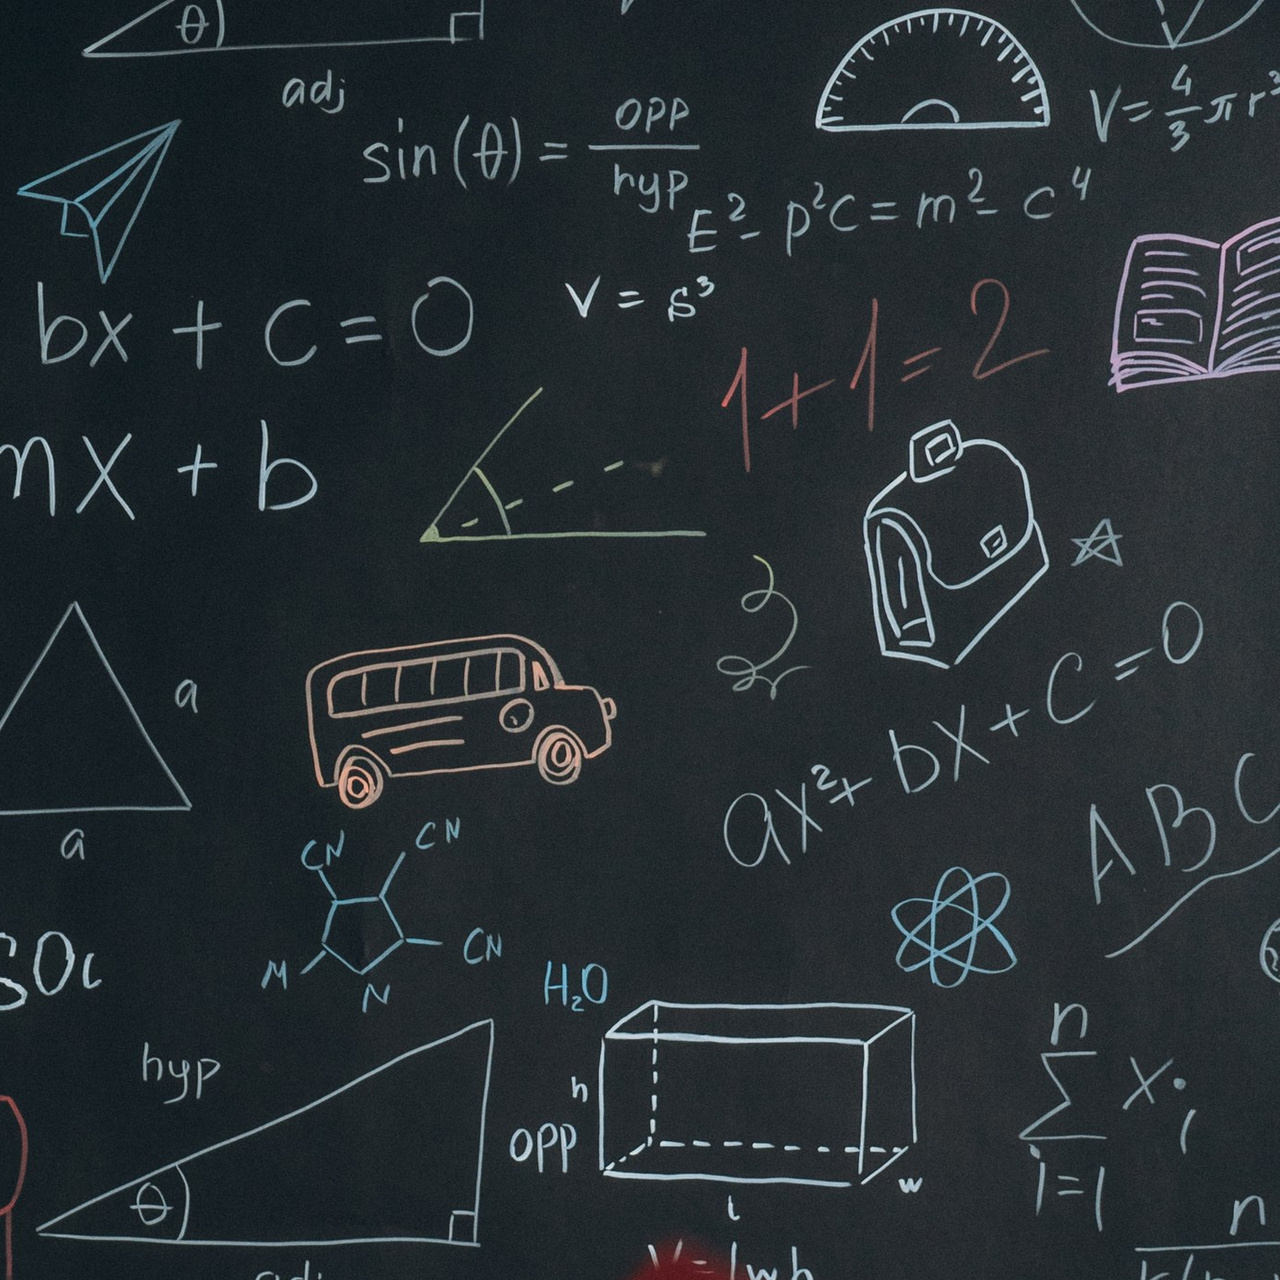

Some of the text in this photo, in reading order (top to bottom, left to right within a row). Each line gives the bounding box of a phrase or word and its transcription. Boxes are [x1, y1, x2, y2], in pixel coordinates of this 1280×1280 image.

[281, 68, 346, 115] adj
[612, 162, 690, 215] hyp
[36, 279, 134, 368] bx
[257, 418, 319, 513] b
[173, 678, 199, 714] a
[59, 827, 86, 861] a
[298, 827, 347, 873] CN
[414, 816, 462, 851] CN
[462, 926, 503, 966] CN
[361, 982, 392, 1014] N
[1049, 1001, 1089, 1047] n
[141, 1041, 222, 1105] hyp
